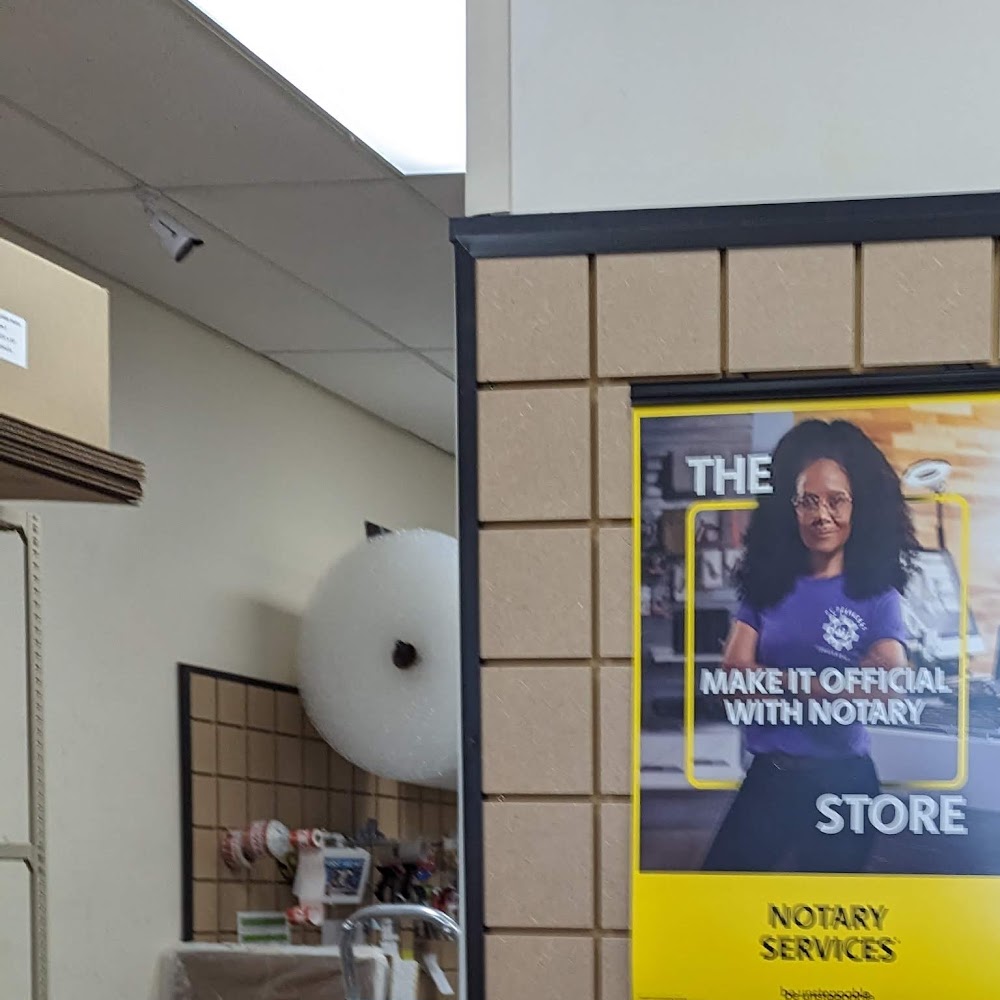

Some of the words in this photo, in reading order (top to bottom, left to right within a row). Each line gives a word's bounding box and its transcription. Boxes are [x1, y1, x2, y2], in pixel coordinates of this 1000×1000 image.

[686, 453, 774, 496] THE
[700, 667, 784, 695] MAKE
[787, 667, 816, 694] IT
[818, 666, 953, 694] OFFICIAL
[723, 698, 803, 726] WITH
[807, 698, 926, 726] NOTARY
[814, 793, 969, 836] STORE
[767, 903, 890, 931] NOTARY
[758, 934, 898, 964] SERVICES
